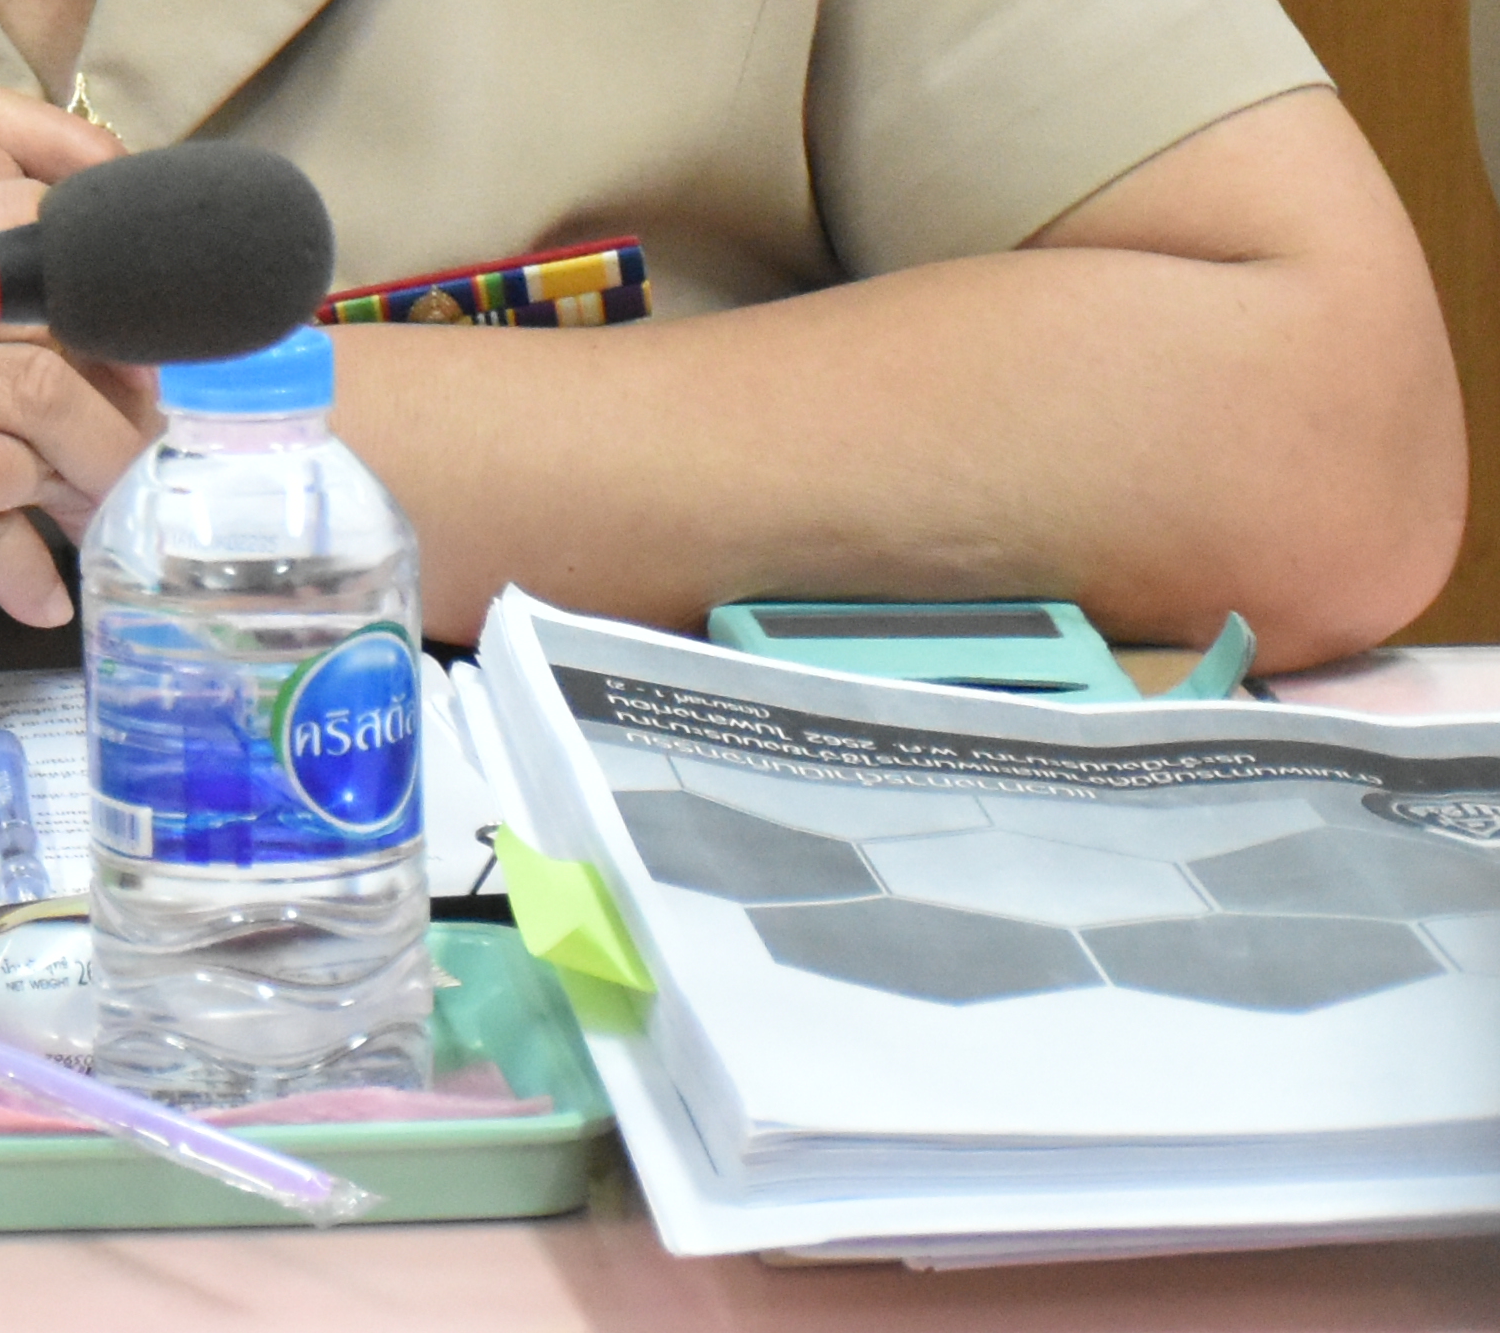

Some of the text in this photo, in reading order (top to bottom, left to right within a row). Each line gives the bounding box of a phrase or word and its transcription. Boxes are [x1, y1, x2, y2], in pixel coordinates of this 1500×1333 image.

[804, 730, 877, 751] 2562
[627, 732, 1097, 799] แนวทางการดำเนินกิจกรรม
[971, 749, 1256, 773] ประจำปีงบประมาณ
